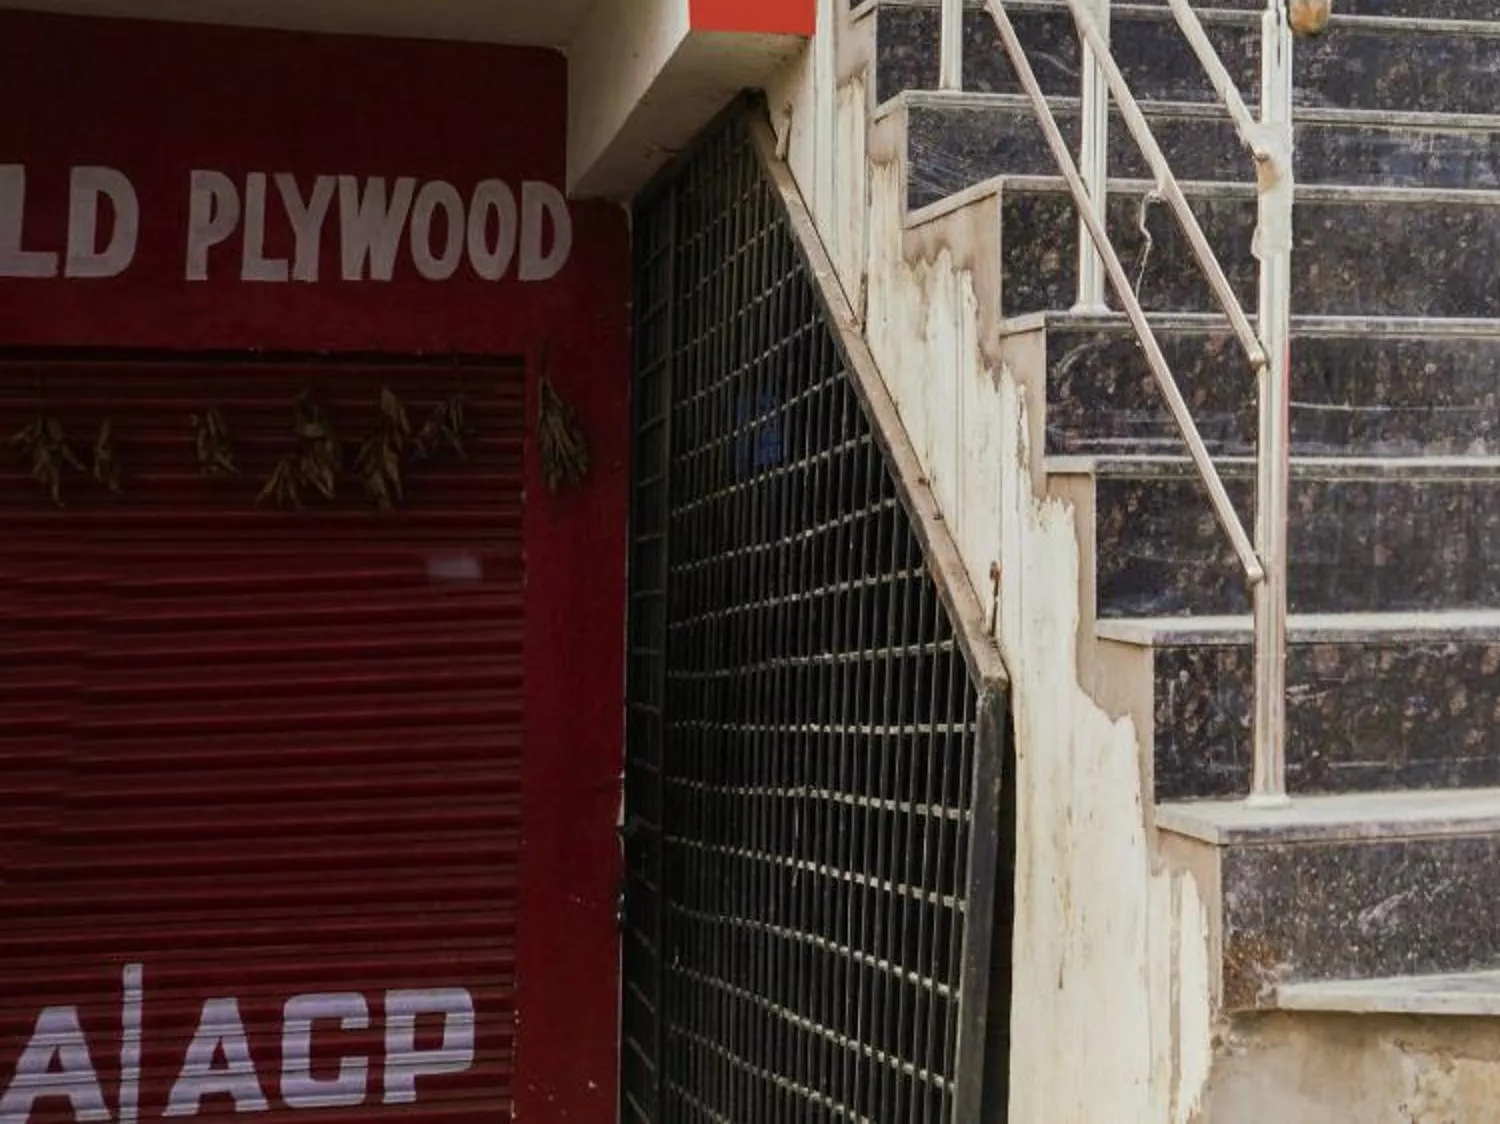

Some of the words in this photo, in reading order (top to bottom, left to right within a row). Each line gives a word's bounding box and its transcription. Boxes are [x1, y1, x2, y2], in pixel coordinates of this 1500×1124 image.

[0, 163, 139, 278] LD
[185, 169, 573, 282] PLYWOOD
[161, 987, 476, 1117] ACP
